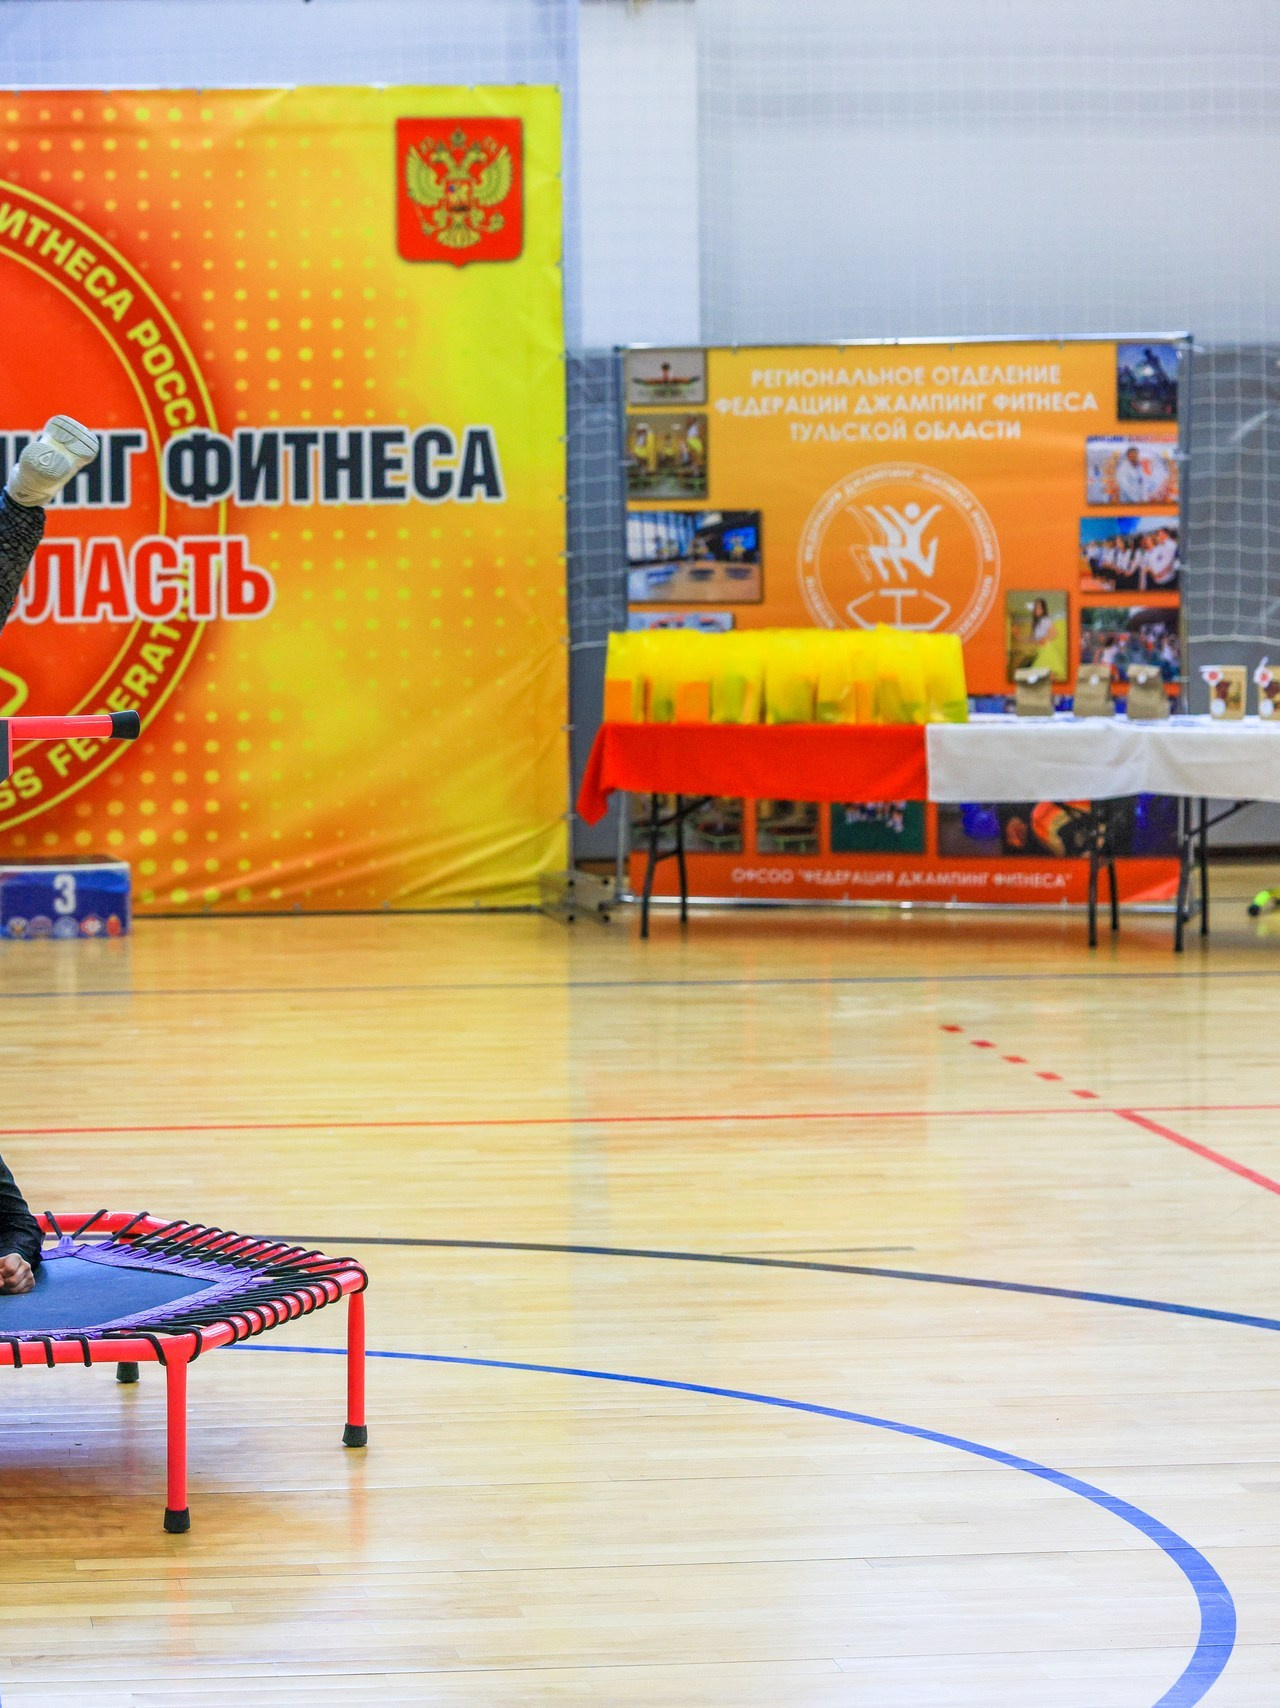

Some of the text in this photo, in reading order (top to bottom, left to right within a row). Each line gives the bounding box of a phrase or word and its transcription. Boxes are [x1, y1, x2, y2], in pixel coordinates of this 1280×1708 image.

[126, 318, 199, 437] РОСС
[751, 364, 1061, 388] РЕГИОНАЛЬНОЕ ОТДЕЛЕНИЕ
[714, 391, 1098, 417] ФЕДЕРАЦИИ ДЖАМПИНГ ФИТНЕСА
[790, 418, 1021, 443] ТУЛЬСКОЙ ОБЛАСТИ
[164, 425, 504, 507] ФИТНЕСА
[53, 873, 77, 915] 3
